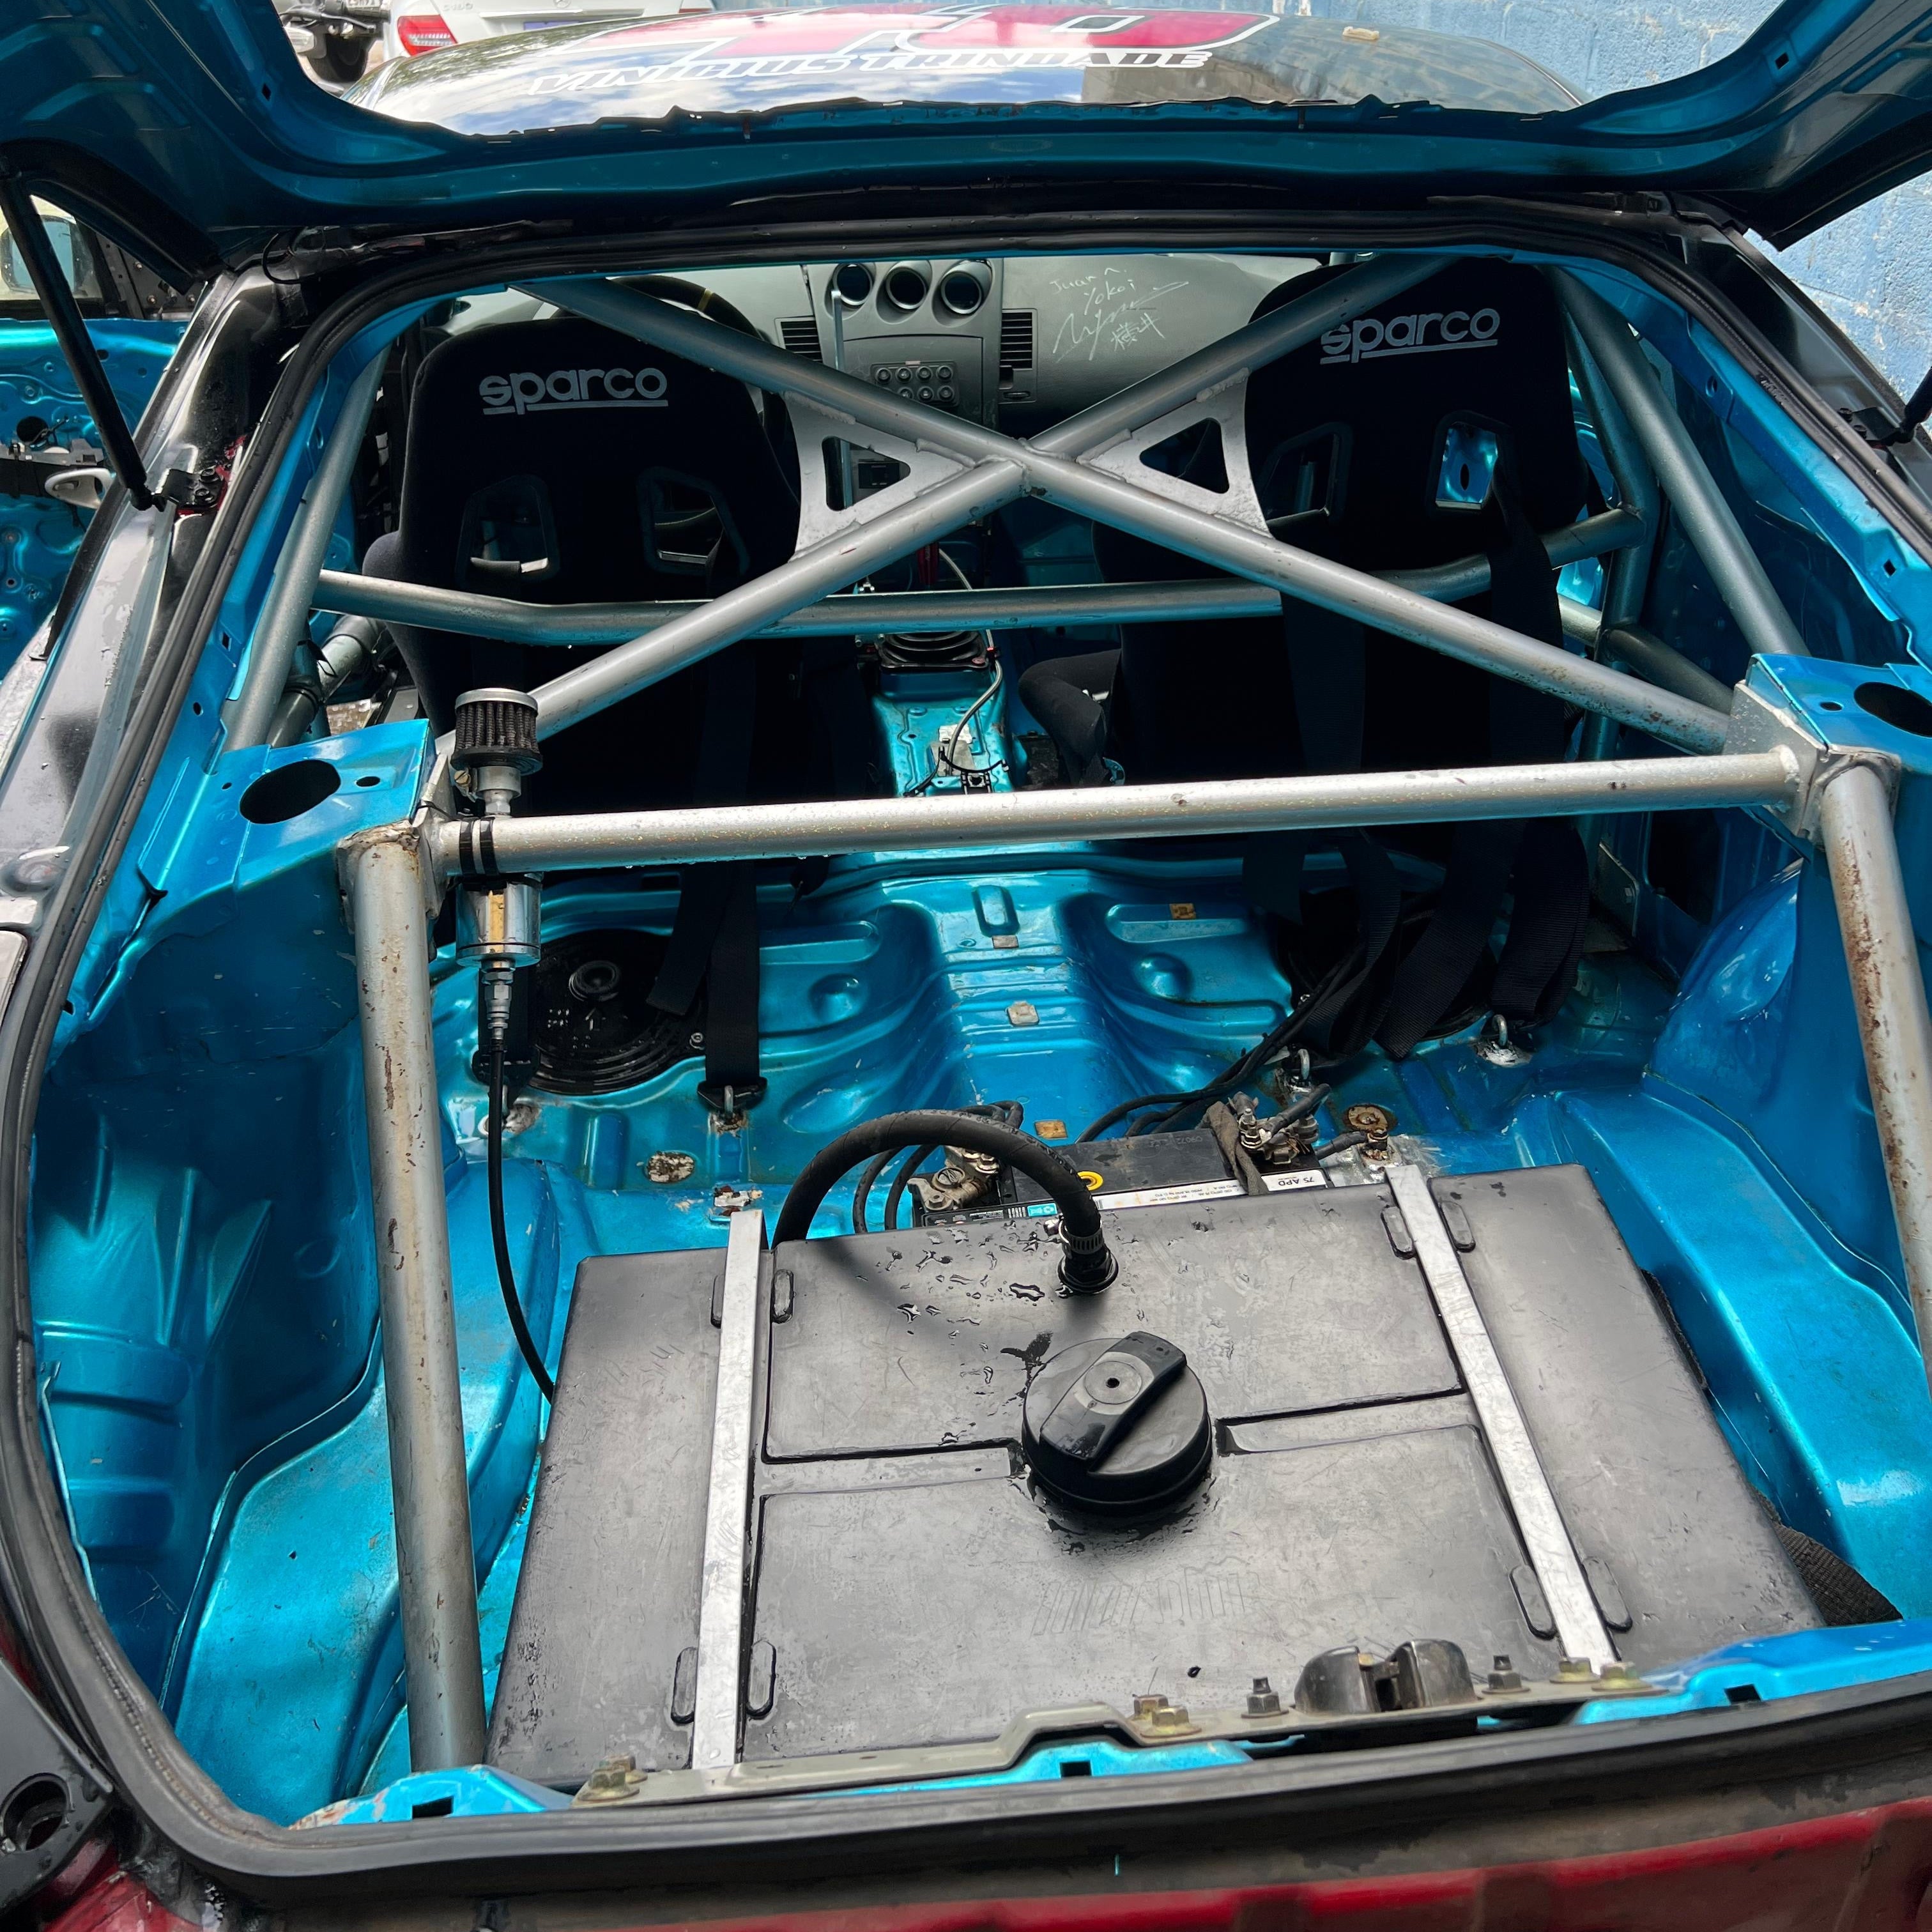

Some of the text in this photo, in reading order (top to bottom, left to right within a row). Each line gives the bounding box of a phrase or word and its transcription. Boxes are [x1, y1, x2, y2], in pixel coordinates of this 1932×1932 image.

[528, 49, 1212, 95] VINICIUS TRINDADE
[1320, 308, 1501, 364] sparco
[479, 367, 668, 415] sparco
[1278, 1178, 1300, 1186] APD
